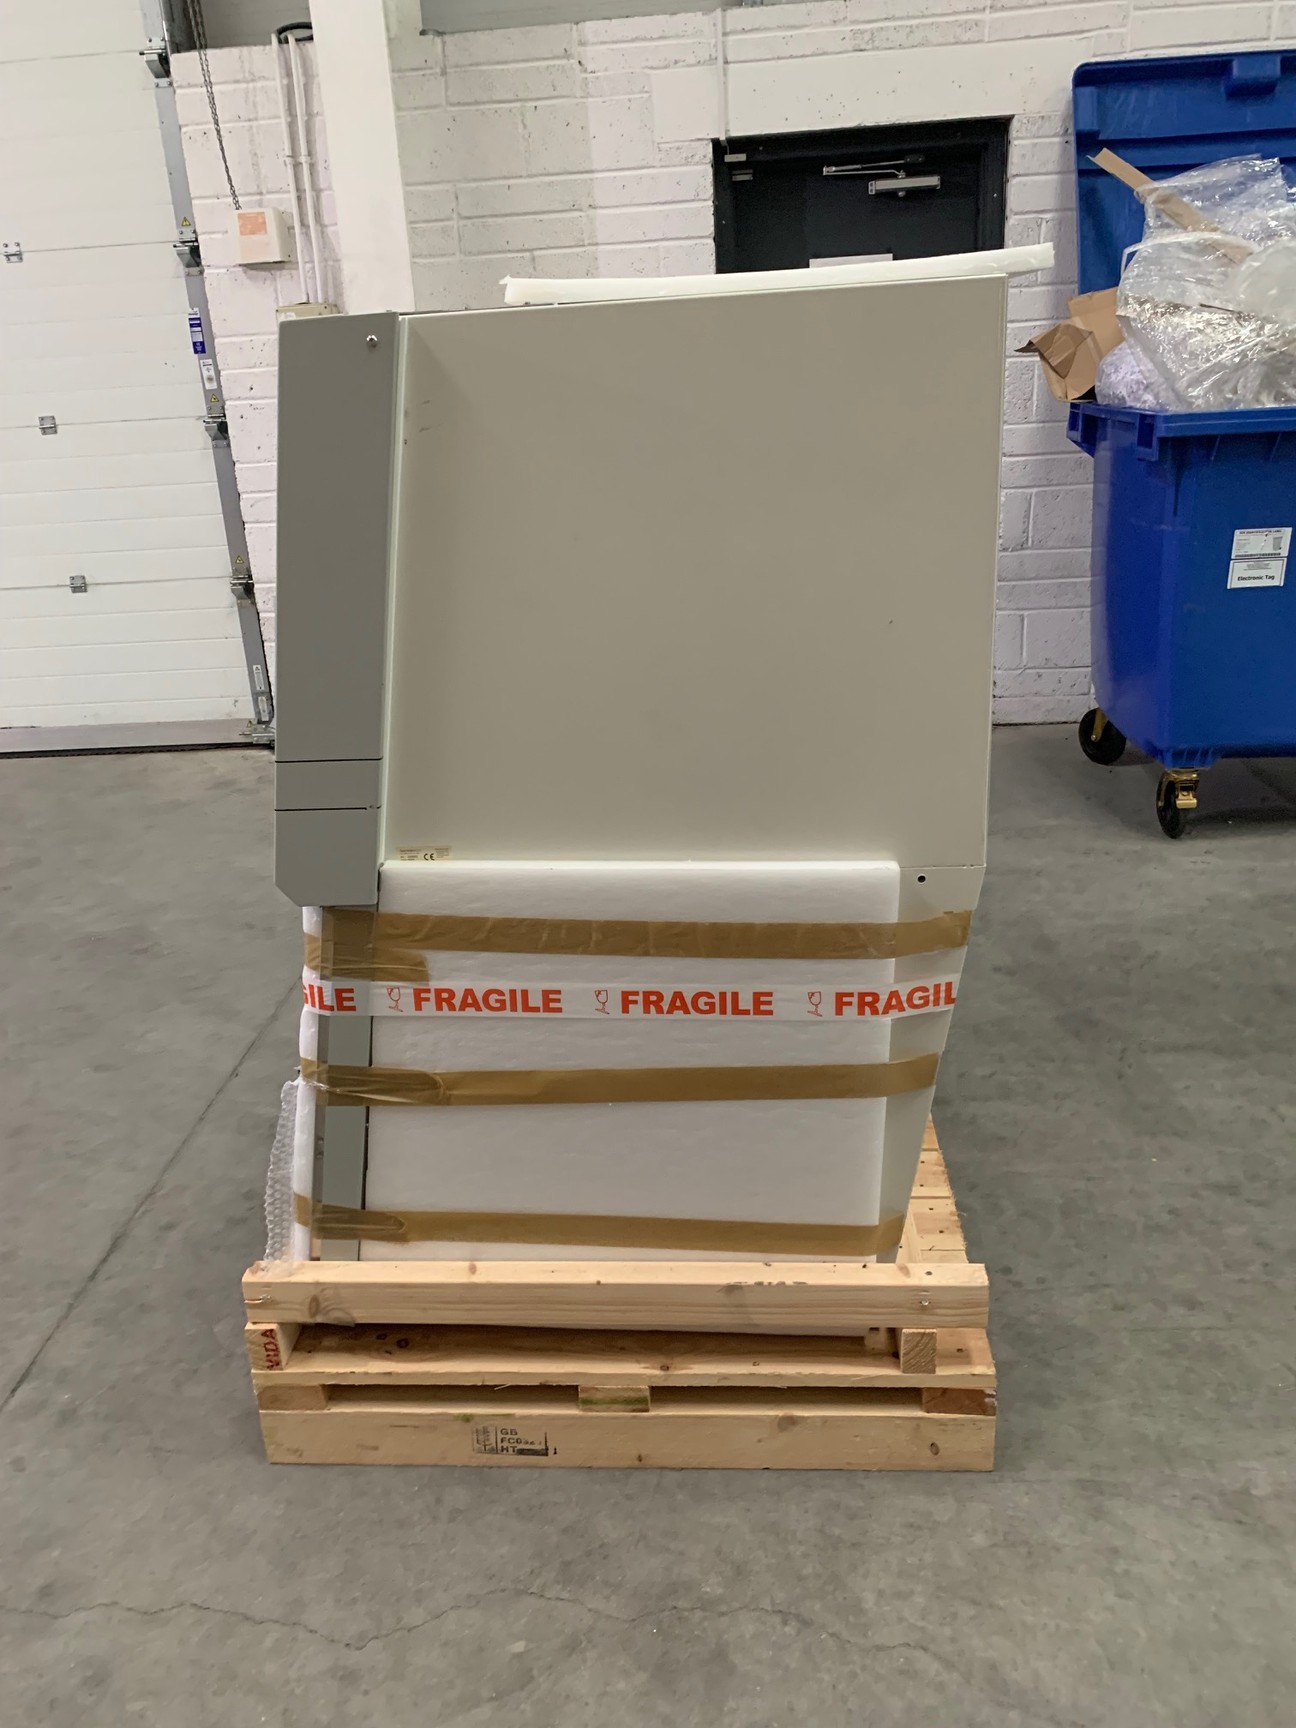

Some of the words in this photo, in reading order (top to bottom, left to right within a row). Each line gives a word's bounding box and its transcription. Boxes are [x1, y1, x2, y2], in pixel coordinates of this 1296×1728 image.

[1265, 574, 1275, 582] Tag
[413, 987, 563, 1014] FRAGILE
[621, 990, 774, 1016] FRAGILE
[500, 1428, 518, 1436] GB
[500, 1445, 518, 1453] HT
